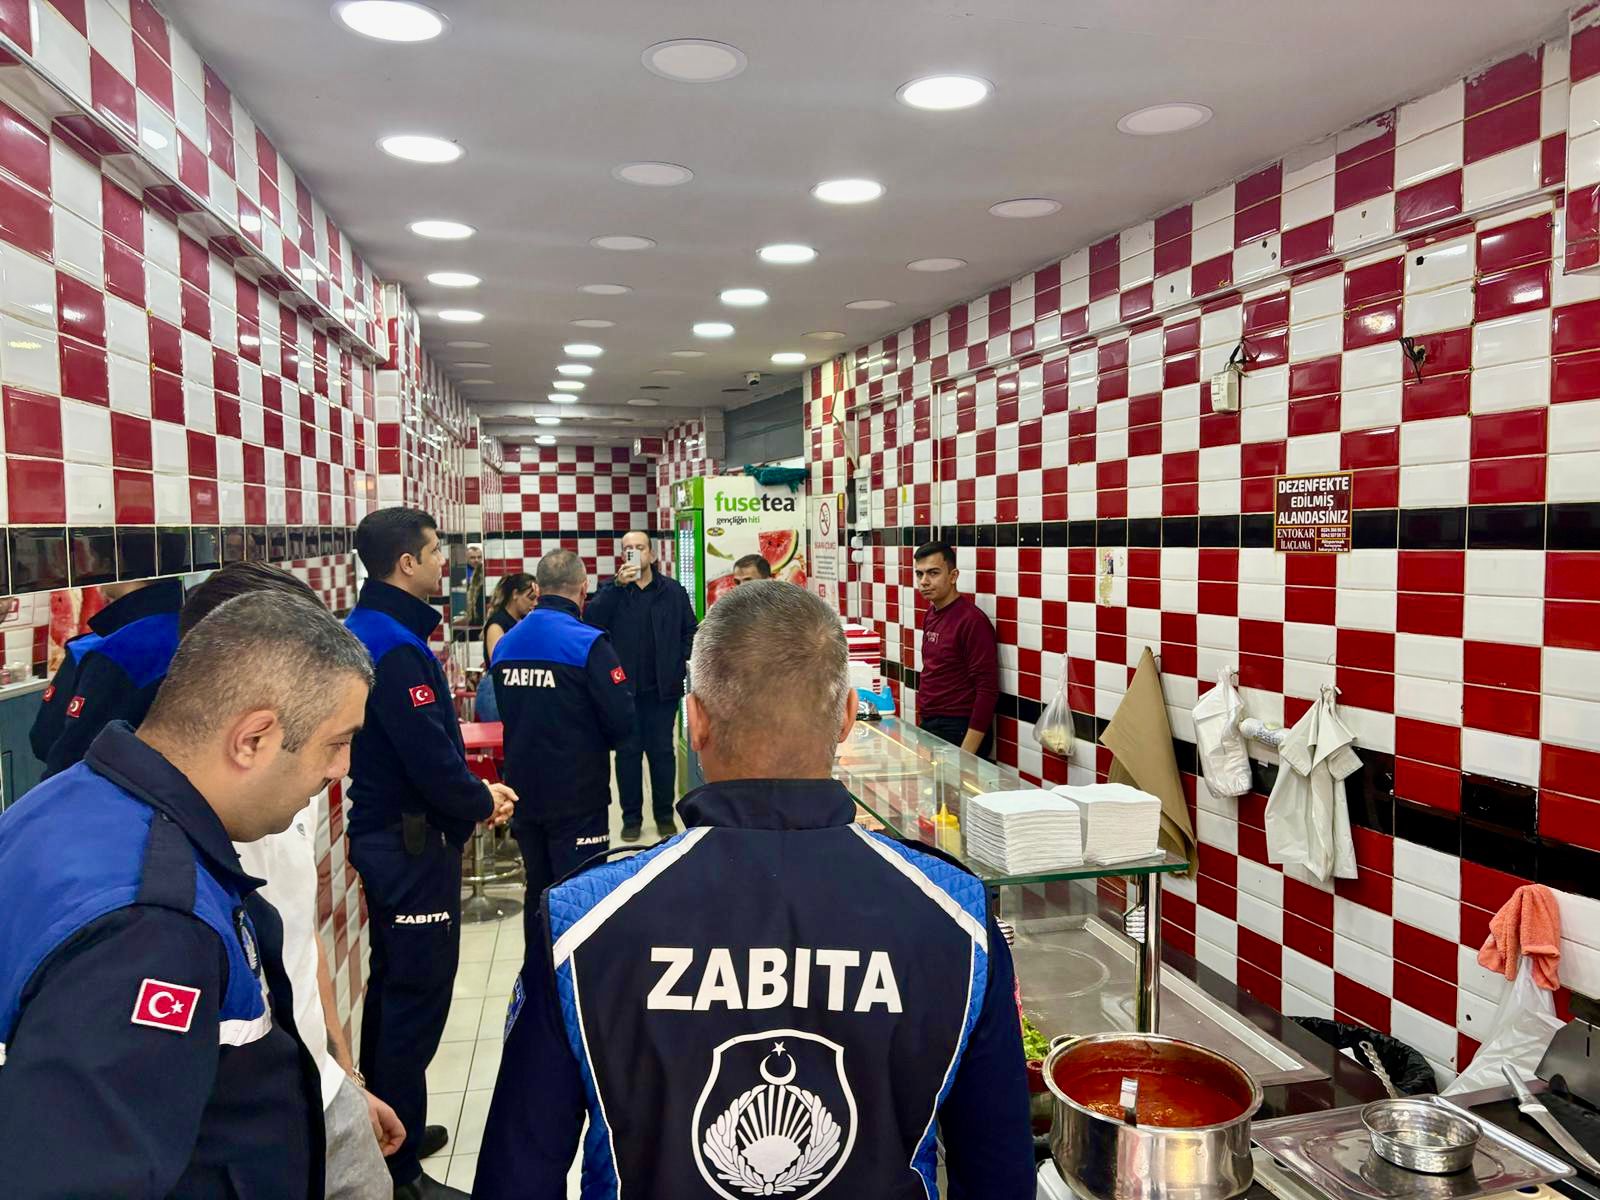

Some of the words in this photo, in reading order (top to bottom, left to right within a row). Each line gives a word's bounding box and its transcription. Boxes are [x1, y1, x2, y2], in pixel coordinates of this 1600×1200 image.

[1278, 477, 1349, 494] DEZENFEKTE
[714, 491, 795, 512] fusetea
[1291, 492, 1334, 511] EDİLMİŞ
[716, 516, 748, 526] gençliğin
[748, 516, 760, 524] hiti
[1278, 510, 1348, 525] ALANDASINIZ
[1277, 528, 1315, 539] ENTOKAR
[1280, 539, 1311, 550] İLAÇLAMA
[502, 668, 556, 688] ZABITA
[576, 834, 609, 846] ZABIT
[395, 911, 450, 924] ZABITA
[647, 947, 903, 1013] ZABITA
